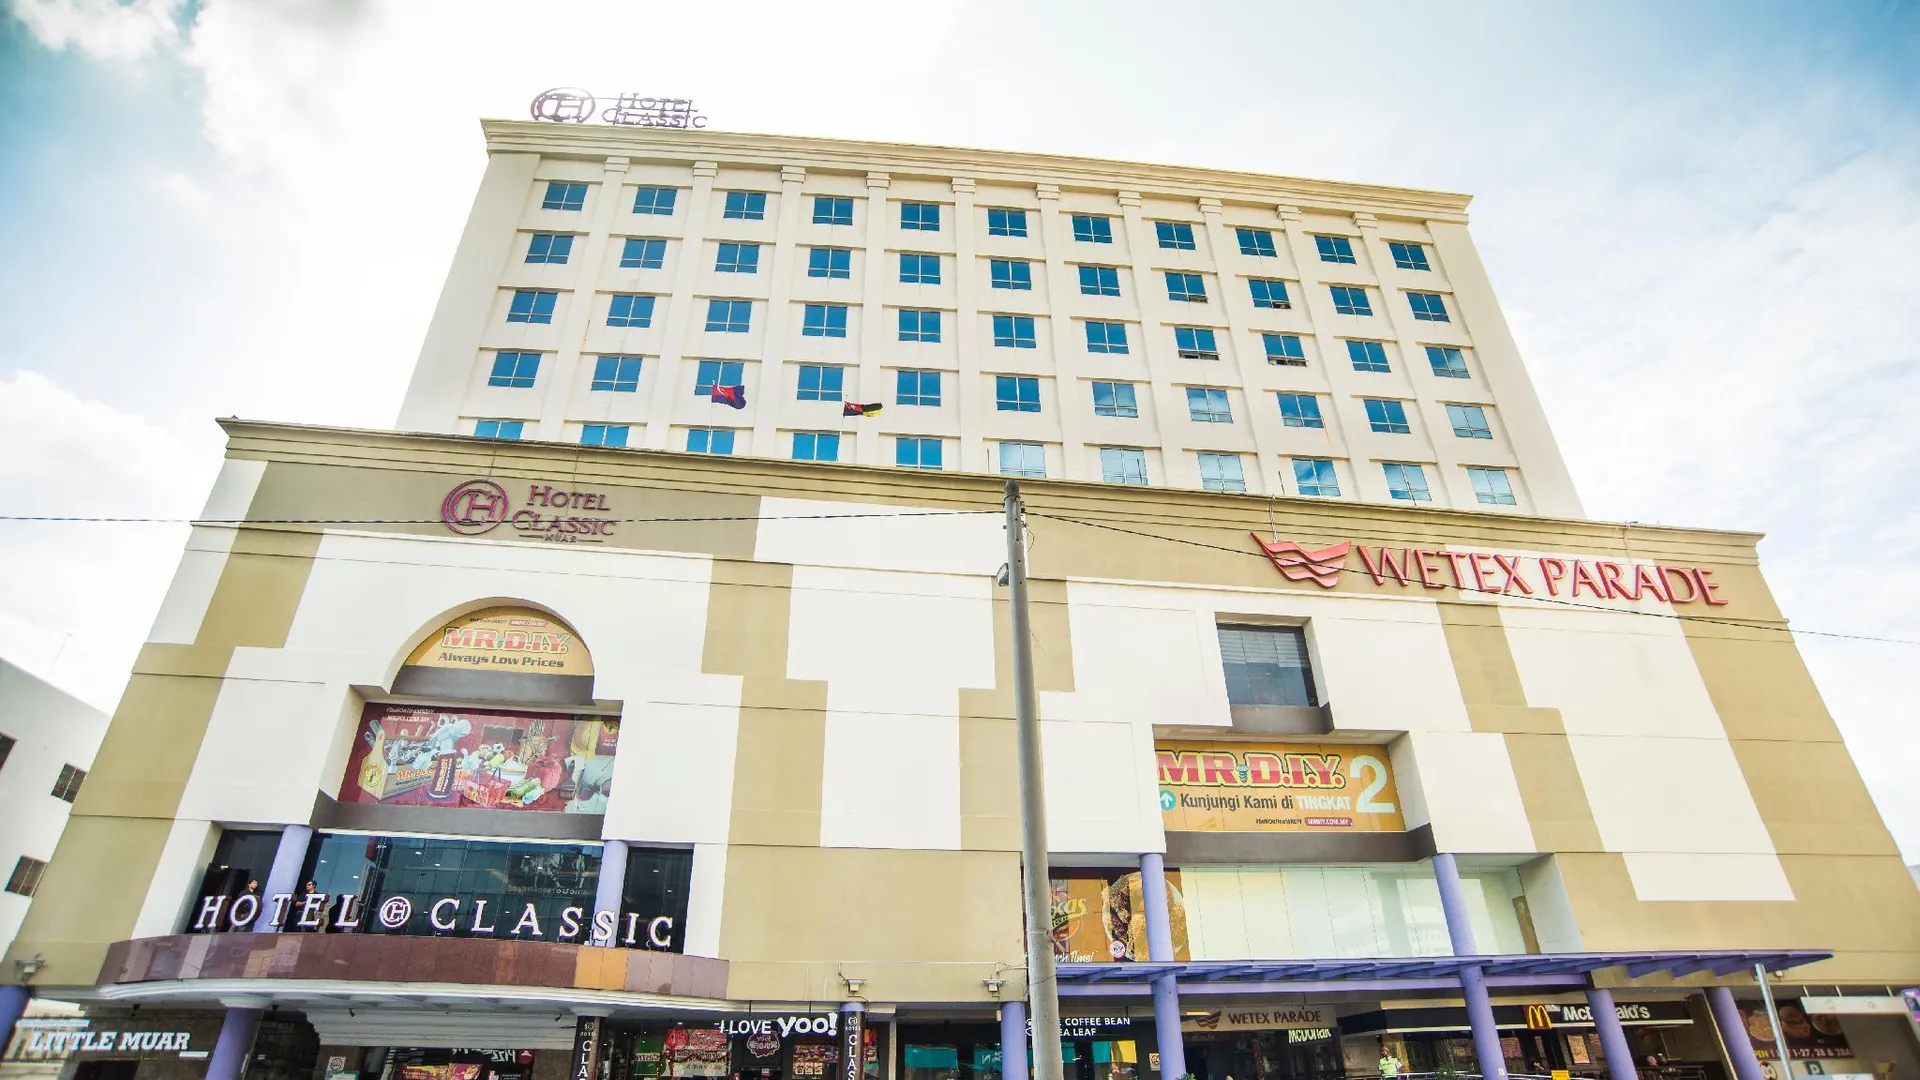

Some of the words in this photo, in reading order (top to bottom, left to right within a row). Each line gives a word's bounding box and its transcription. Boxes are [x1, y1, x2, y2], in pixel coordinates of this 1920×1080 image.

[526, 484, 611, 511] HOTEL
[512, 508, 617, 536] CLASSIC
[1357, 544, 1534, 595] WETEX
[1539, 557, 1729, 606] PARADE
[438, 652, 489, 664] Always
[492, 655, 519, 665] Low
[522, 656, 565, 668] Prices
[1350, 754, 1396, 814] 2
[1180, 793, 1241, 812] Kunjungi
[1244, 794, 1278, 811] Kami
[1281, 794, 1294, 810] di
[1295, 794, 1351, 811] TINGKAT
[194, 892, 359, 929] HOTEL
[429, 897, 674, 948] CLASSIC
[728, 1020, 772, 1034] LOVE
[1064, 1017, 1102, 1026] COFFEE
[1104, 1016, 1131, 1026] BEAN
[1228, 1011, 1271, 1025] WETEX
[1273, 1009, 1322, 1024] PARADE
[27, 1031, 118, 1052] LITTLE
[118, 1031, 191, 1051] MUAR
[1073, 1027, 1097, 1037] LEAF
